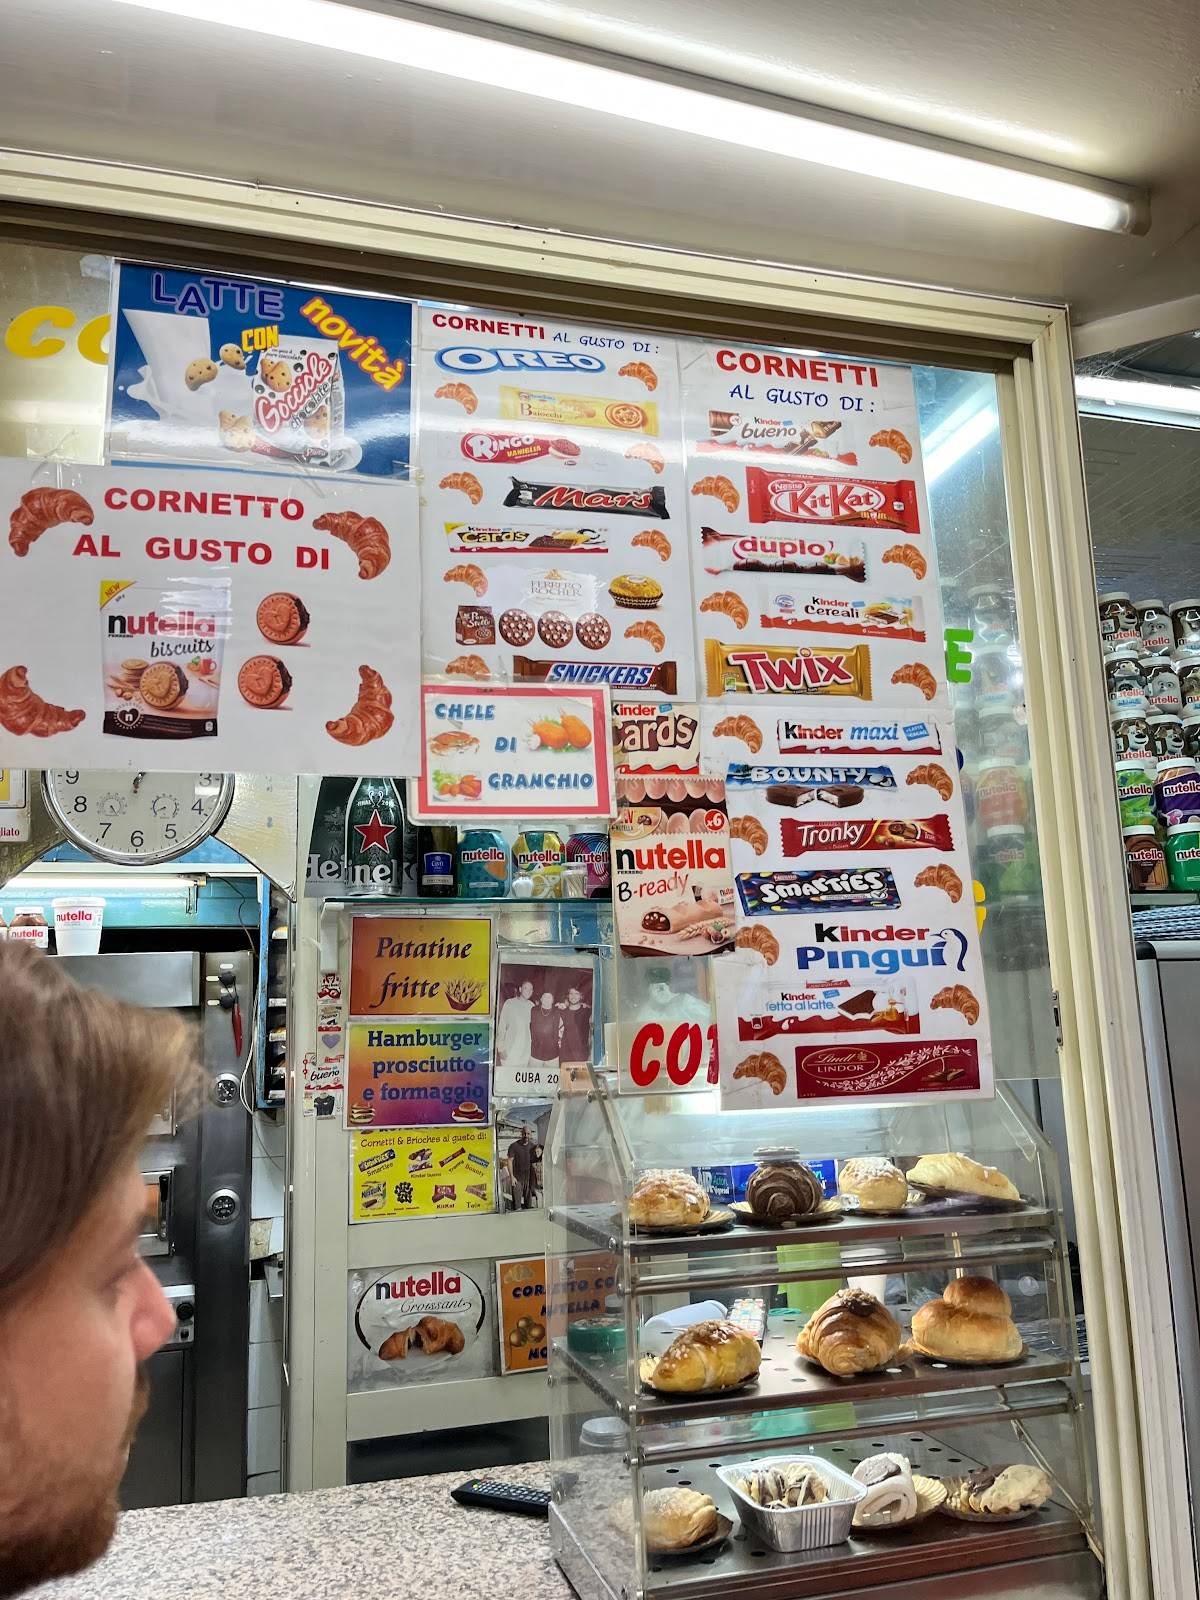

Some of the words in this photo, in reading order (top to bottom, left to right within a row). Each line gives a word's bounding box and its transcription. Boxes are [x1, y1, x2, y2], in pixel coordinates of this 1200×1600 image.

[152, 272, 284, 320] LATTE
[241, 325, 280, 352] CON
[432, 313, 545, 339] CORNETTI
[552, 331, 571, 343] AL
[579, 335, 625, 349] GUSTO
[300, 297, 404, 391] novità
[438, 348, 604, 371] OREO
[716, 350, 878, 387] CORNETTI
[255, 352, 332, 434] Gocciole
[729, 384, 755, 400] AL
[766, 388, 829, 407] GUSTO
[741, 424, 797, 439] bueno
[104, 487, 304, 521] CORNETTO
[534, 486, 651, 509] Mars
[790, 484, 874, 517] KitKat
[73, 535, 121, 558] AL
[145, 536, 272, 565] GUSTO
[296, 546, 330, 570] DI
[739, 536, 826, 558] duplo
[104, 582, 121, 597] NEW
[812, 596, 849, 607] Kinder
[804, 604, 859, 619] Cereali
[108, 611, 216, 637] nutella
[151, 639, 215, 658] biscuits
[548, 664, 653, 686] SNICKERS
[434, 703, 496, 721] CHELE
[784, 722, 844, 740] Kinder
[849, 723, 900, 741] maxi
[494, 736, 517, 753] DI
[488, 773, 594, 792] GRANCHIO
[750, 767, 868, 783] BOUNTY
[73, 796, 88, 812] 8
[191, 801, 204, 816] 4
[706, 813, 721, 828] x6
[100, 822, 112, 839] 7
[130, 830, 144, 847] 6
[164, 824, 177, 839] 5
[797, 822, 865, 847] Tronky
[463, 849, 505, 862] nutella
[519, 850, 561, 863] nutella
[616, 839, 726, 870] nutella
[1127, 848, 1163, 861] nutella
[617, 870, 689, 902] B-ready
[56, 910, 92, 922] nutella
[12, 930, 44, 938] nutella
[814, 923, 930, 943] Kinder
[375, 937, 473, 959] Patatine
[369, 972, 441, 1009] fritte
[781, 992, 816, 1001] Kinder
[368, 1029, 482, 1051] Hamburger
[310, 1069, 340, 1081] bueno
[373, 1056, 476, 1078] prosciutto
[817, 1064, 865, 1073] LINDOR
[515, 1071, 540, 1084] CUBA
[362, 1086, 374, 1101] e
[381, 1081, 484, 1104] formaggio
[361, 1137, 395, 1148] Cornetti
[397, 1136, 404, 1146] &
[406, 1135, 441, 1145] Brioches
[452, 1133, 475, 1144] gusto
[375, 1271, 462, 1301] nutella
[400, 1297, 468, 1314] Croissant
